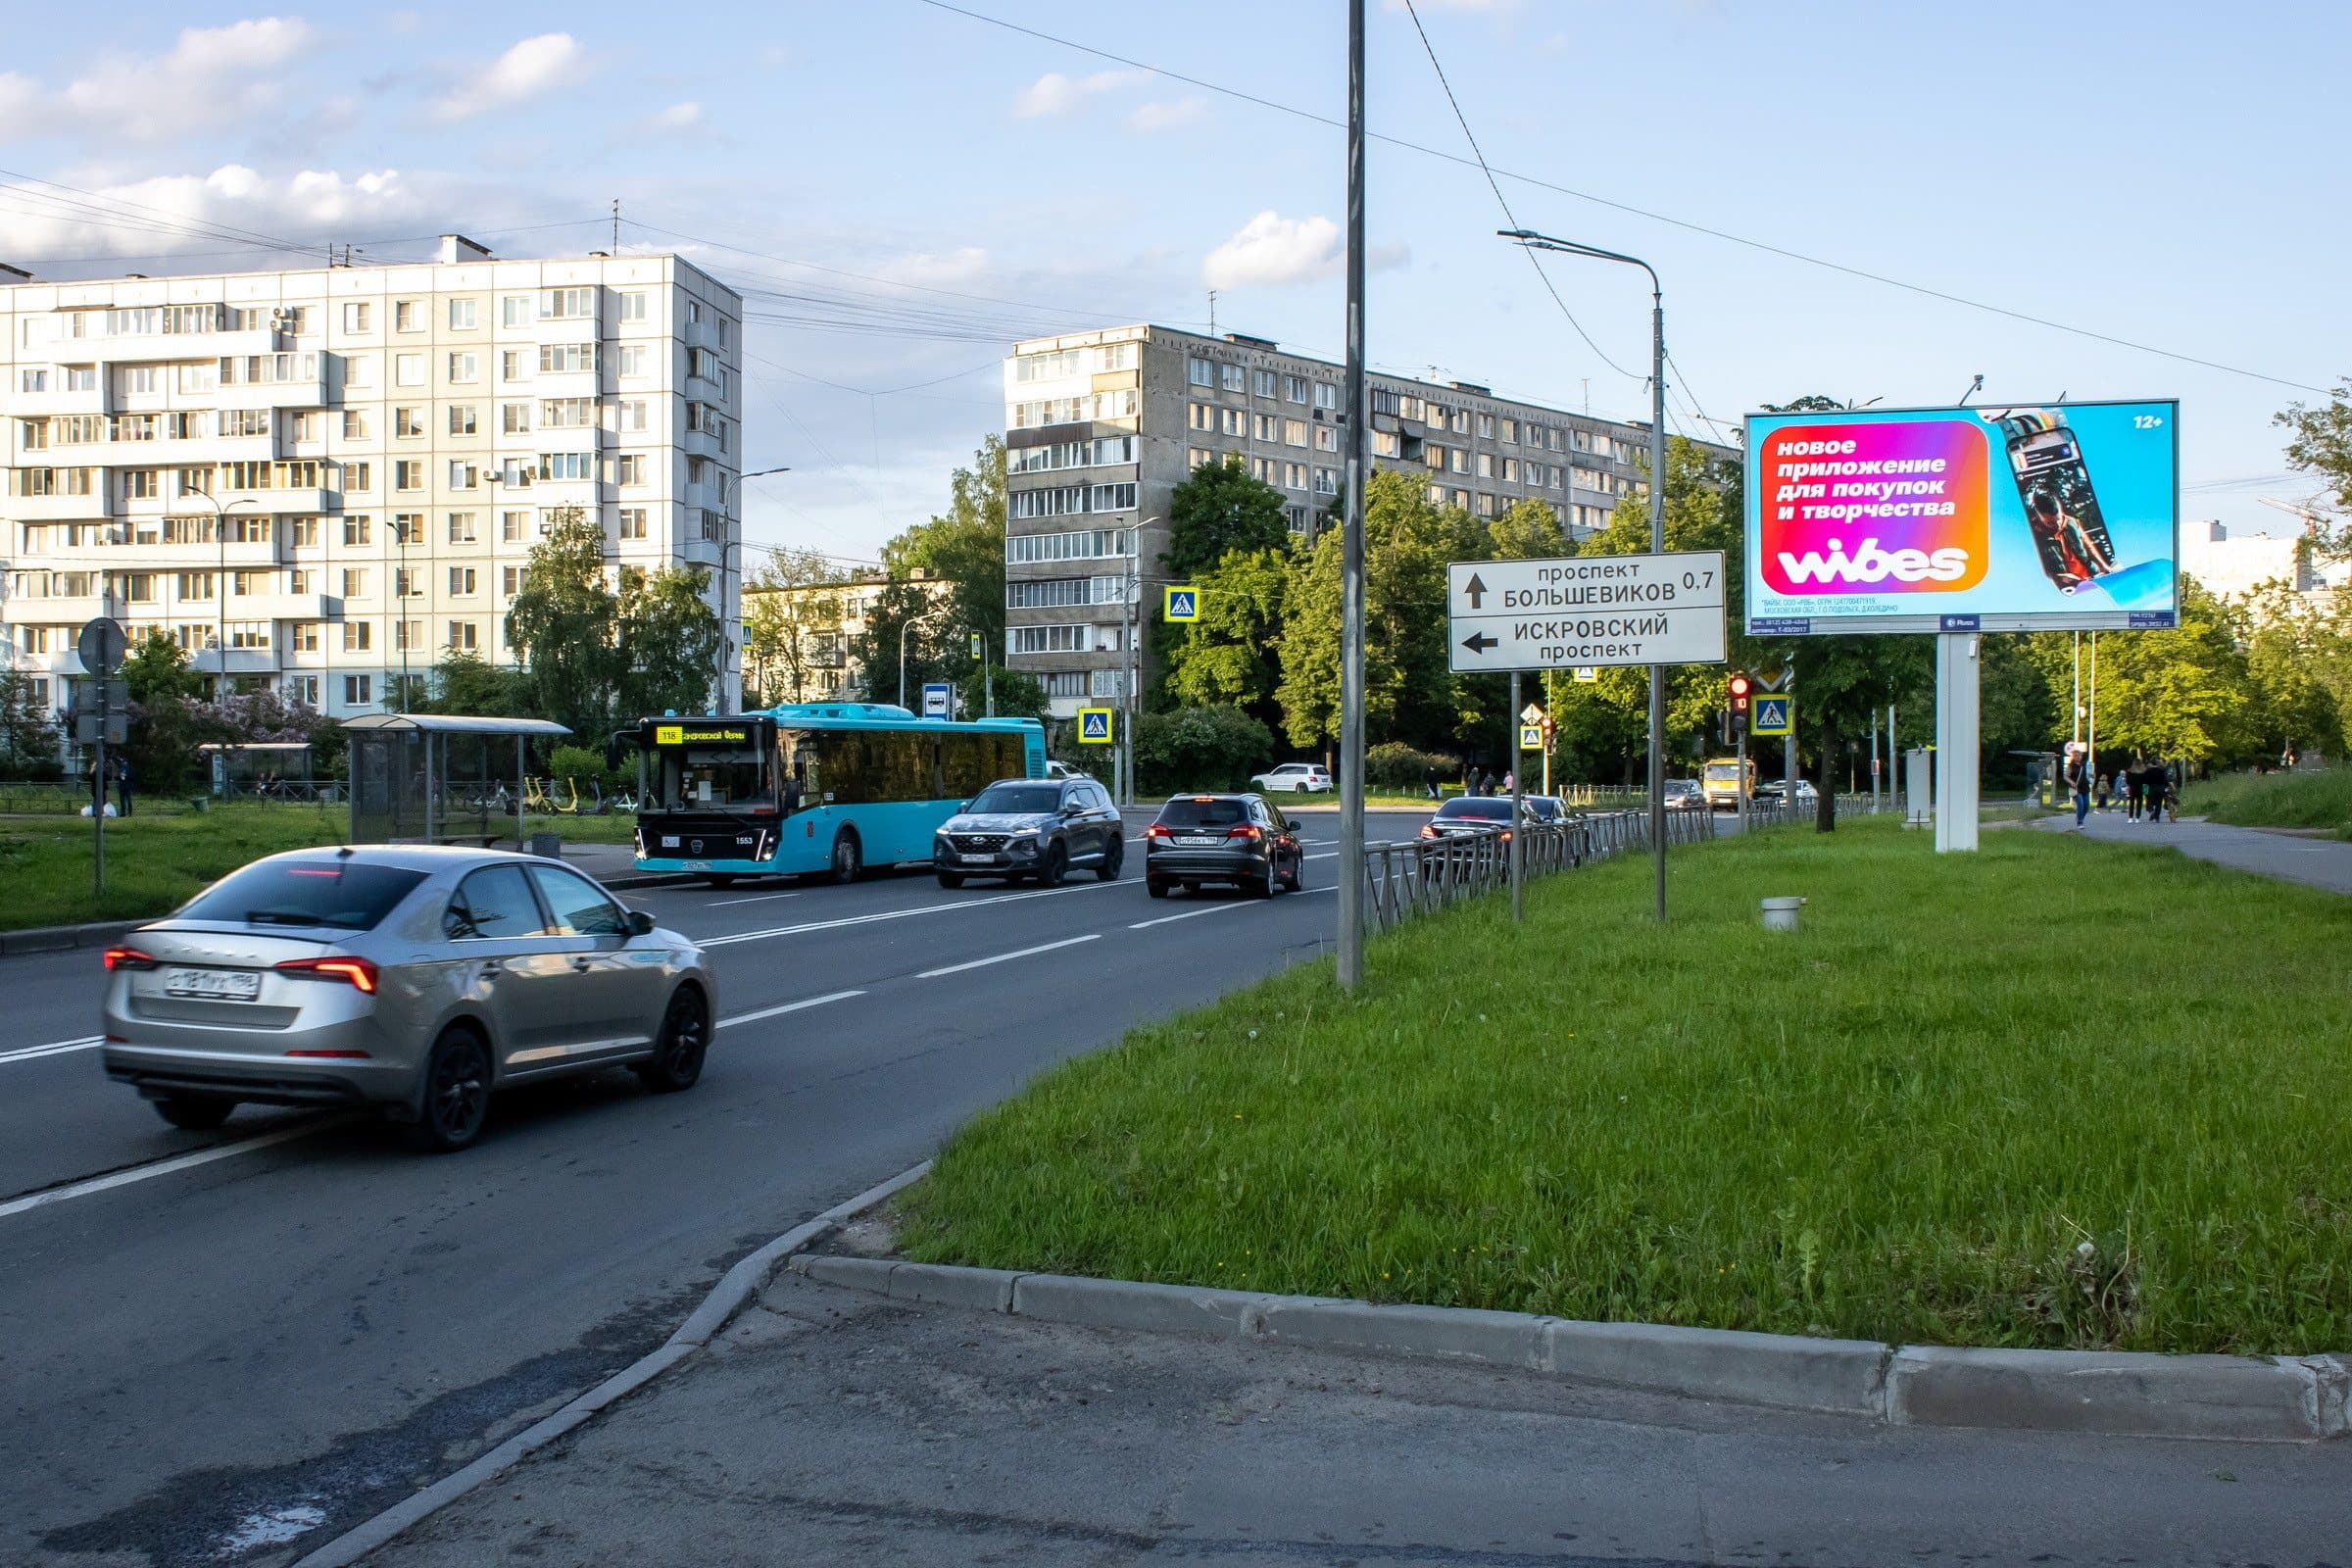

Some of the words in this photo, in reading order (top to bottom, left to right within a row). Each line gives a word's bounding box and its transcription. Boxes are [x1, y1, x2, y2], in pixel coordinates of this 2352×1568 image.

[2133, 415, 2163, 429] 12+
[1777, 440, 1856, 456] новое
[1777, 459, 1946, 482] приложение
[1776, 483, 1826, 502] для
[1832, 480, 1946, 501] покупок
[1777, 506, 1794, 520] и
[1801, 501, 1955, 523] творчества
[1777, 538, 1969, 584] wibes
[1538, 564, 1640, 584] проспект
[1682, 571, 1714, 591] 0,7
[1504, 583, 1676, 608] БОЛЬШЕВИКОВ
[1514, 612, 1668, 640] ИСКРОВСКИЙ
[1540, 643, 1642, 662] проспект
[662, 731, 676, 740] 118
